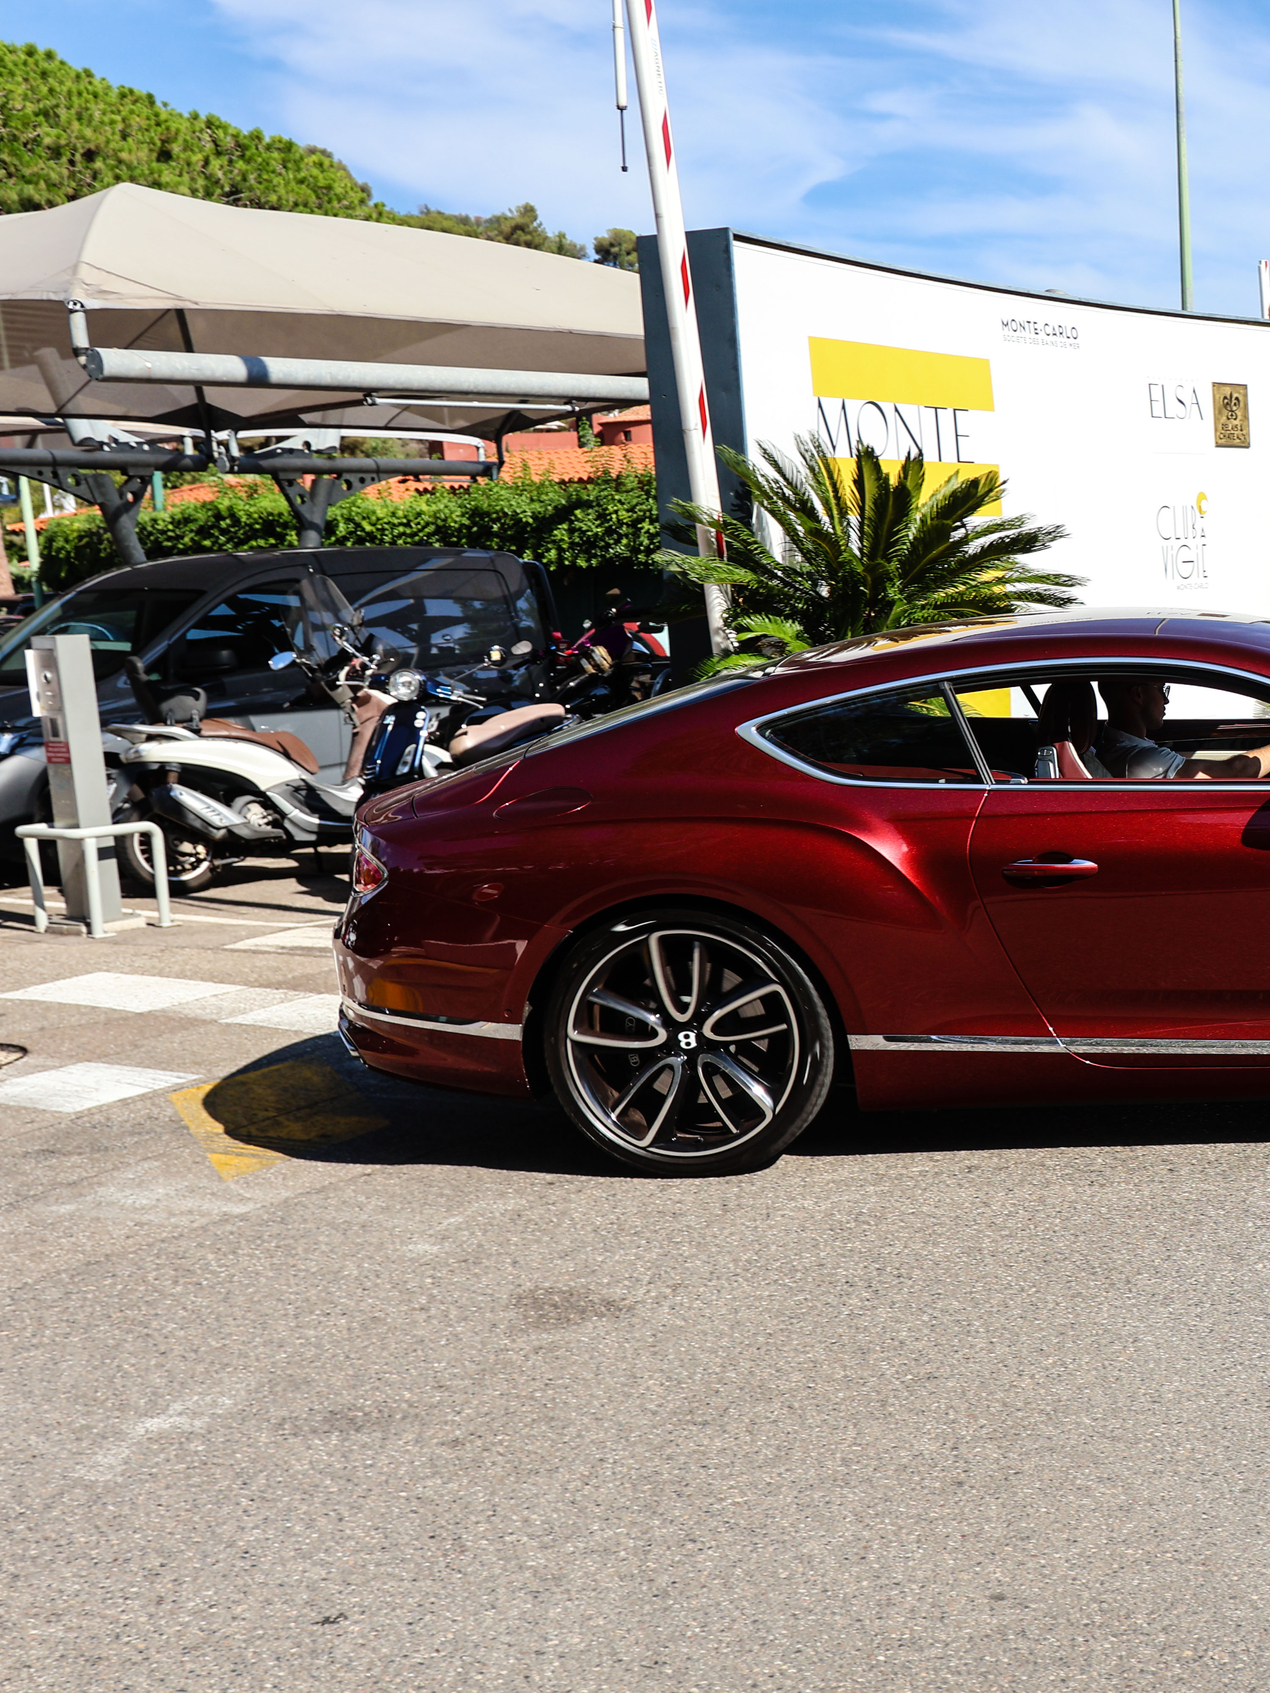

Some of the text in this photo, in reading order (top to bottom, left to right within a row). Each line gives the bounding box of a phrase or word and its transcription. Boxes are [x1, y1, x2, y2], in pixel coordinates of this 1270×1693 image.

[1148, 382, 1204, 421] ELSA
[817, 397, 974, 463] MONTE
[1156, 505, 1197, 540] CLUB
